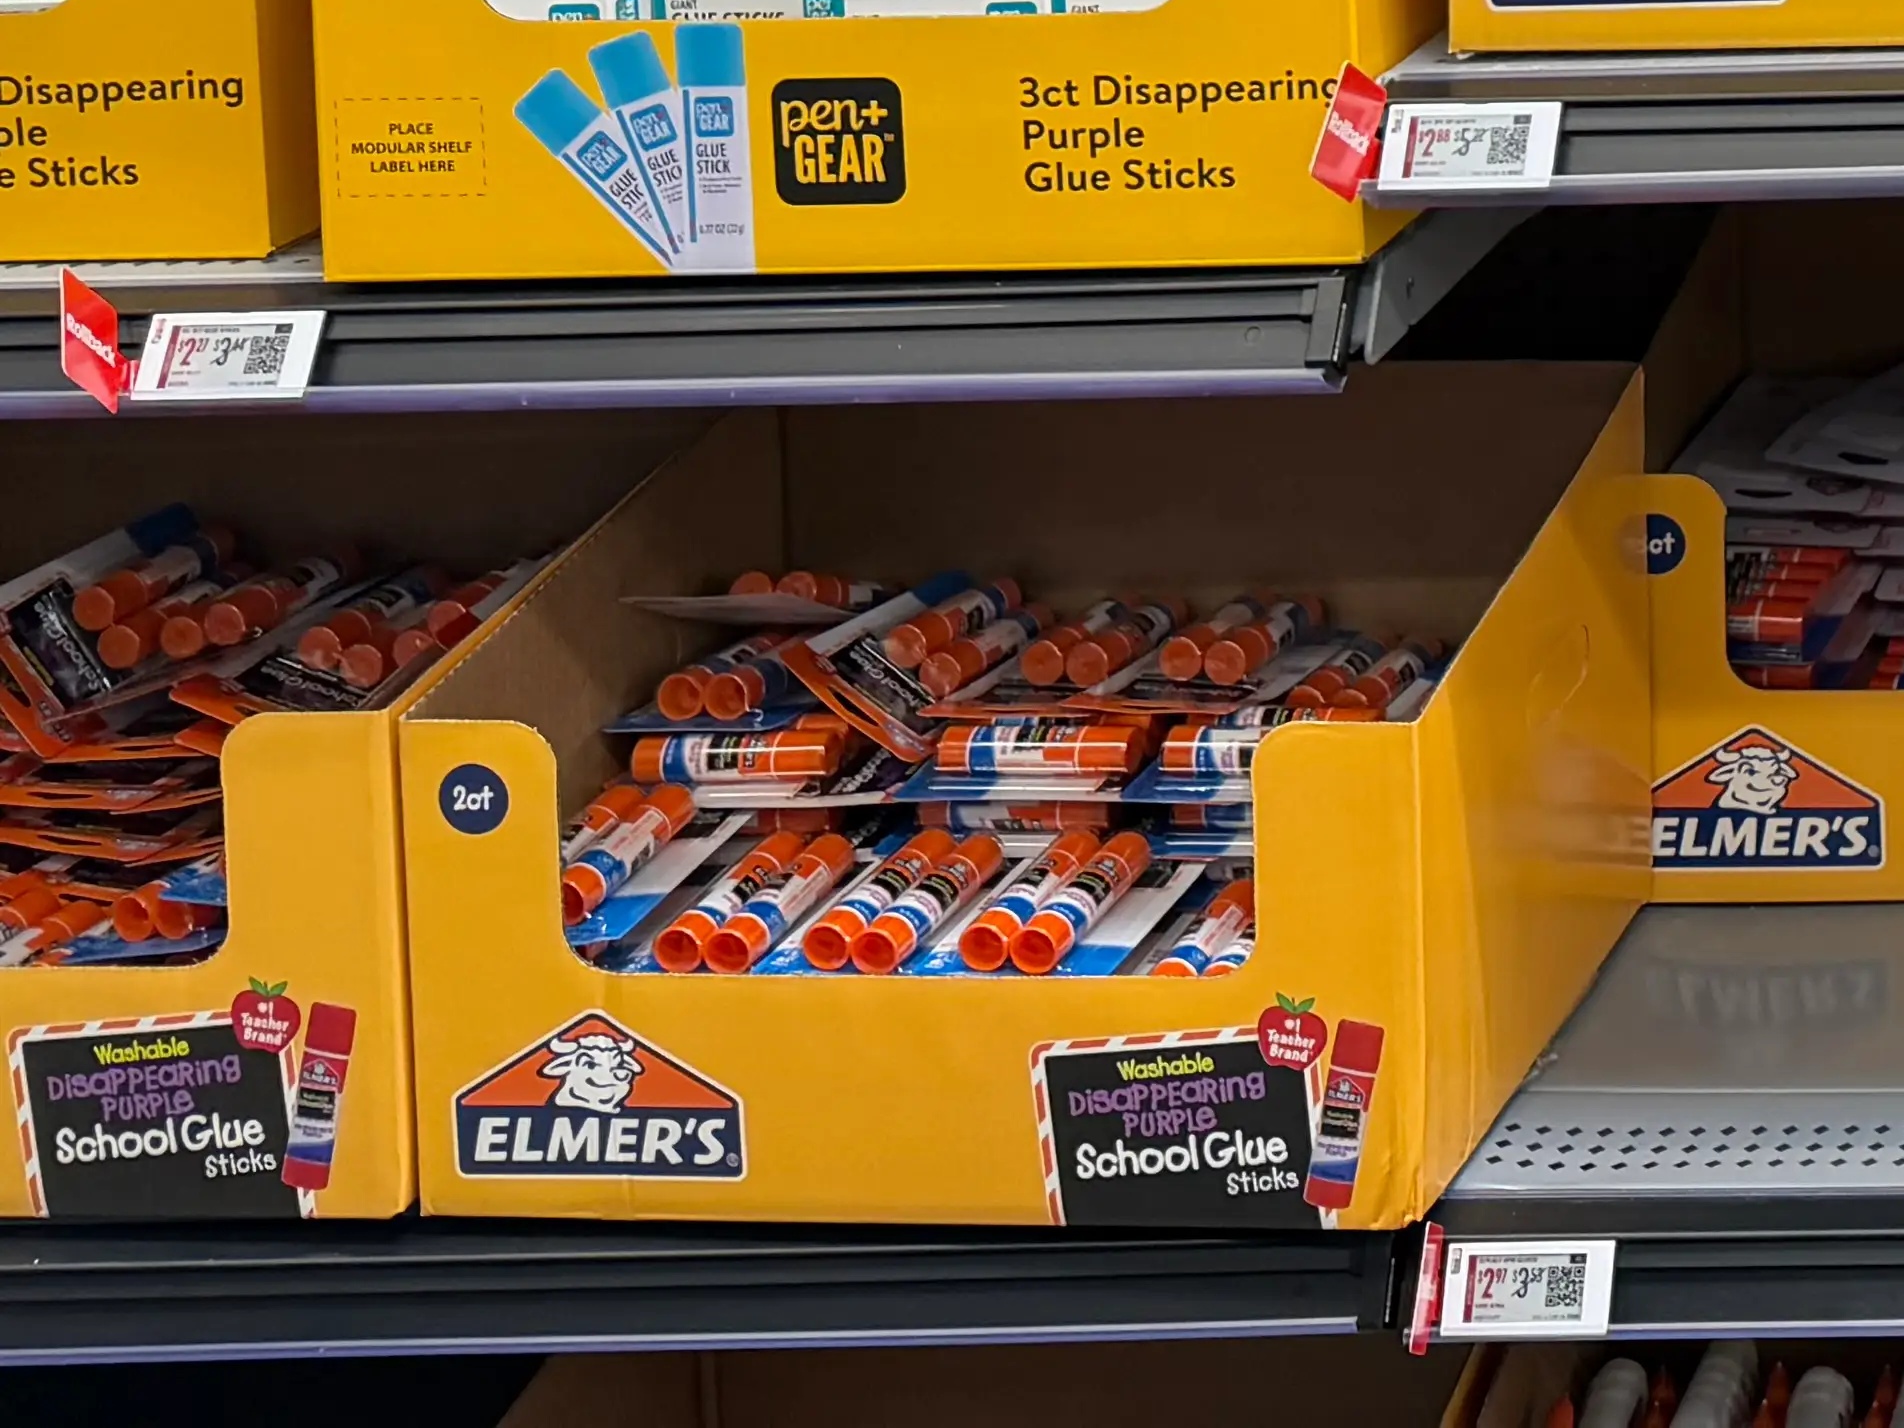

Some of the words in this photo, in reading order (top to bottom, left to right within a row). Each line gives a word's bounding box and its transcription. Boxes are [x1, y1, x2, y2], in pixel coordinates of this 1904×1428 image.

[1020, 77, 1080, 109] 3ct
[389, 122, 433, 136] PLACE
[1022, 120, 1145, 158] Purple
[351, 141, 425, 155] MODULAR
[429, 139, 473, 154] SHELF
[794, 138, 887, 184] GEAR
[29, 155, 140, 189] Sticks
[1024, 161, 1110, 193] Glue
[1123, 158, 1236, 191] Sticks
[1650, 817, 1869, 858] ELMER'S
[93, 1036, 189, 1065] Washable
[1117, 1052, 1215, 1080] Washable
[55, 1117, 179, 1165] School
[184, 1113, 266, 1151] Glue
[474, 1116, 727, 1163] ELMER'S
[1076, 1133, 1199, 1180] School
[1203, 1129, 1288, 1166] Glue
[205, 1150, 277, 1178] Sticks
[1227, 1169, 1299, 1196] Sticks
